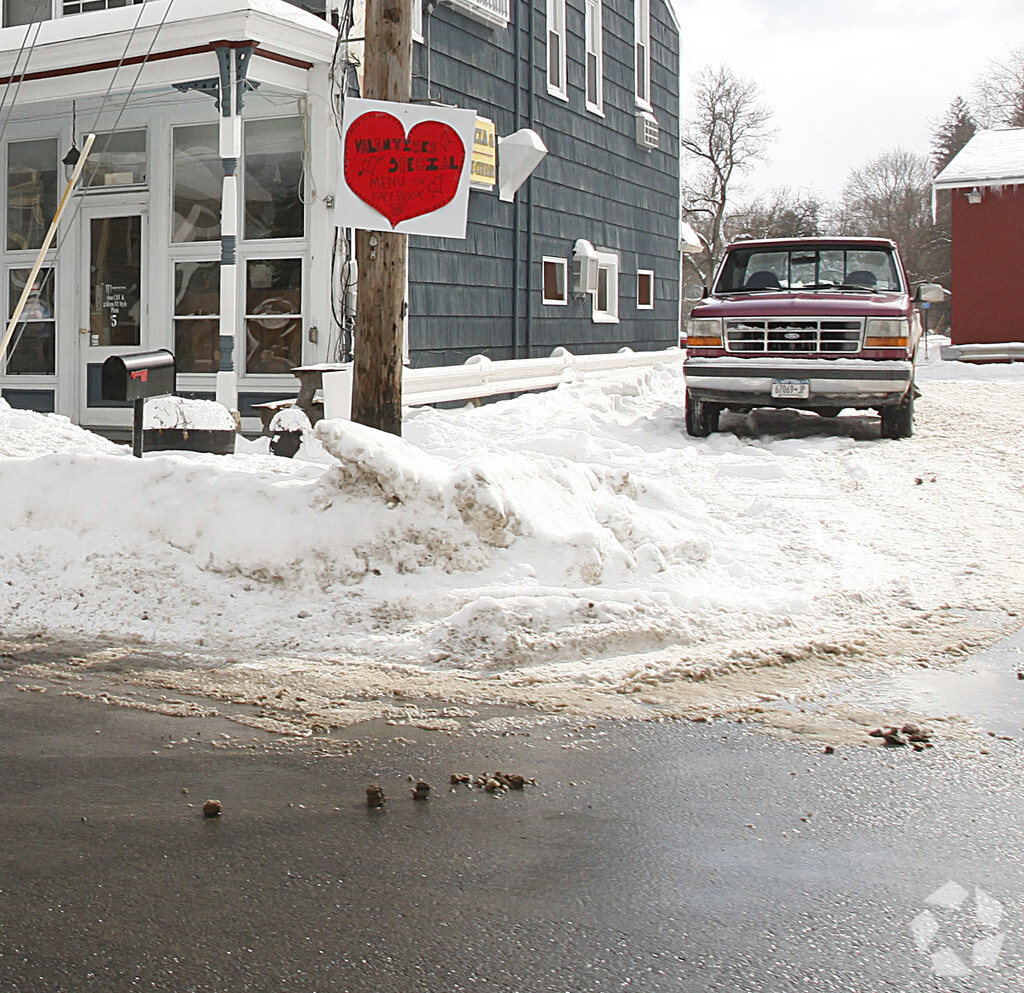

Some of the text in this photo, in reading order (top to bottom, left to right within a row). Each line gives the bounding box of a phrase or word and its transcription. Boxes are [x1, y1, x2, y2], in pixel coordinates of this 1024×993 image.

[388, 156, 459, 173] SPECIAL
[369, 176, 426, 190] MENU ON
[371, 191, 424, 202] FACEBOOK
